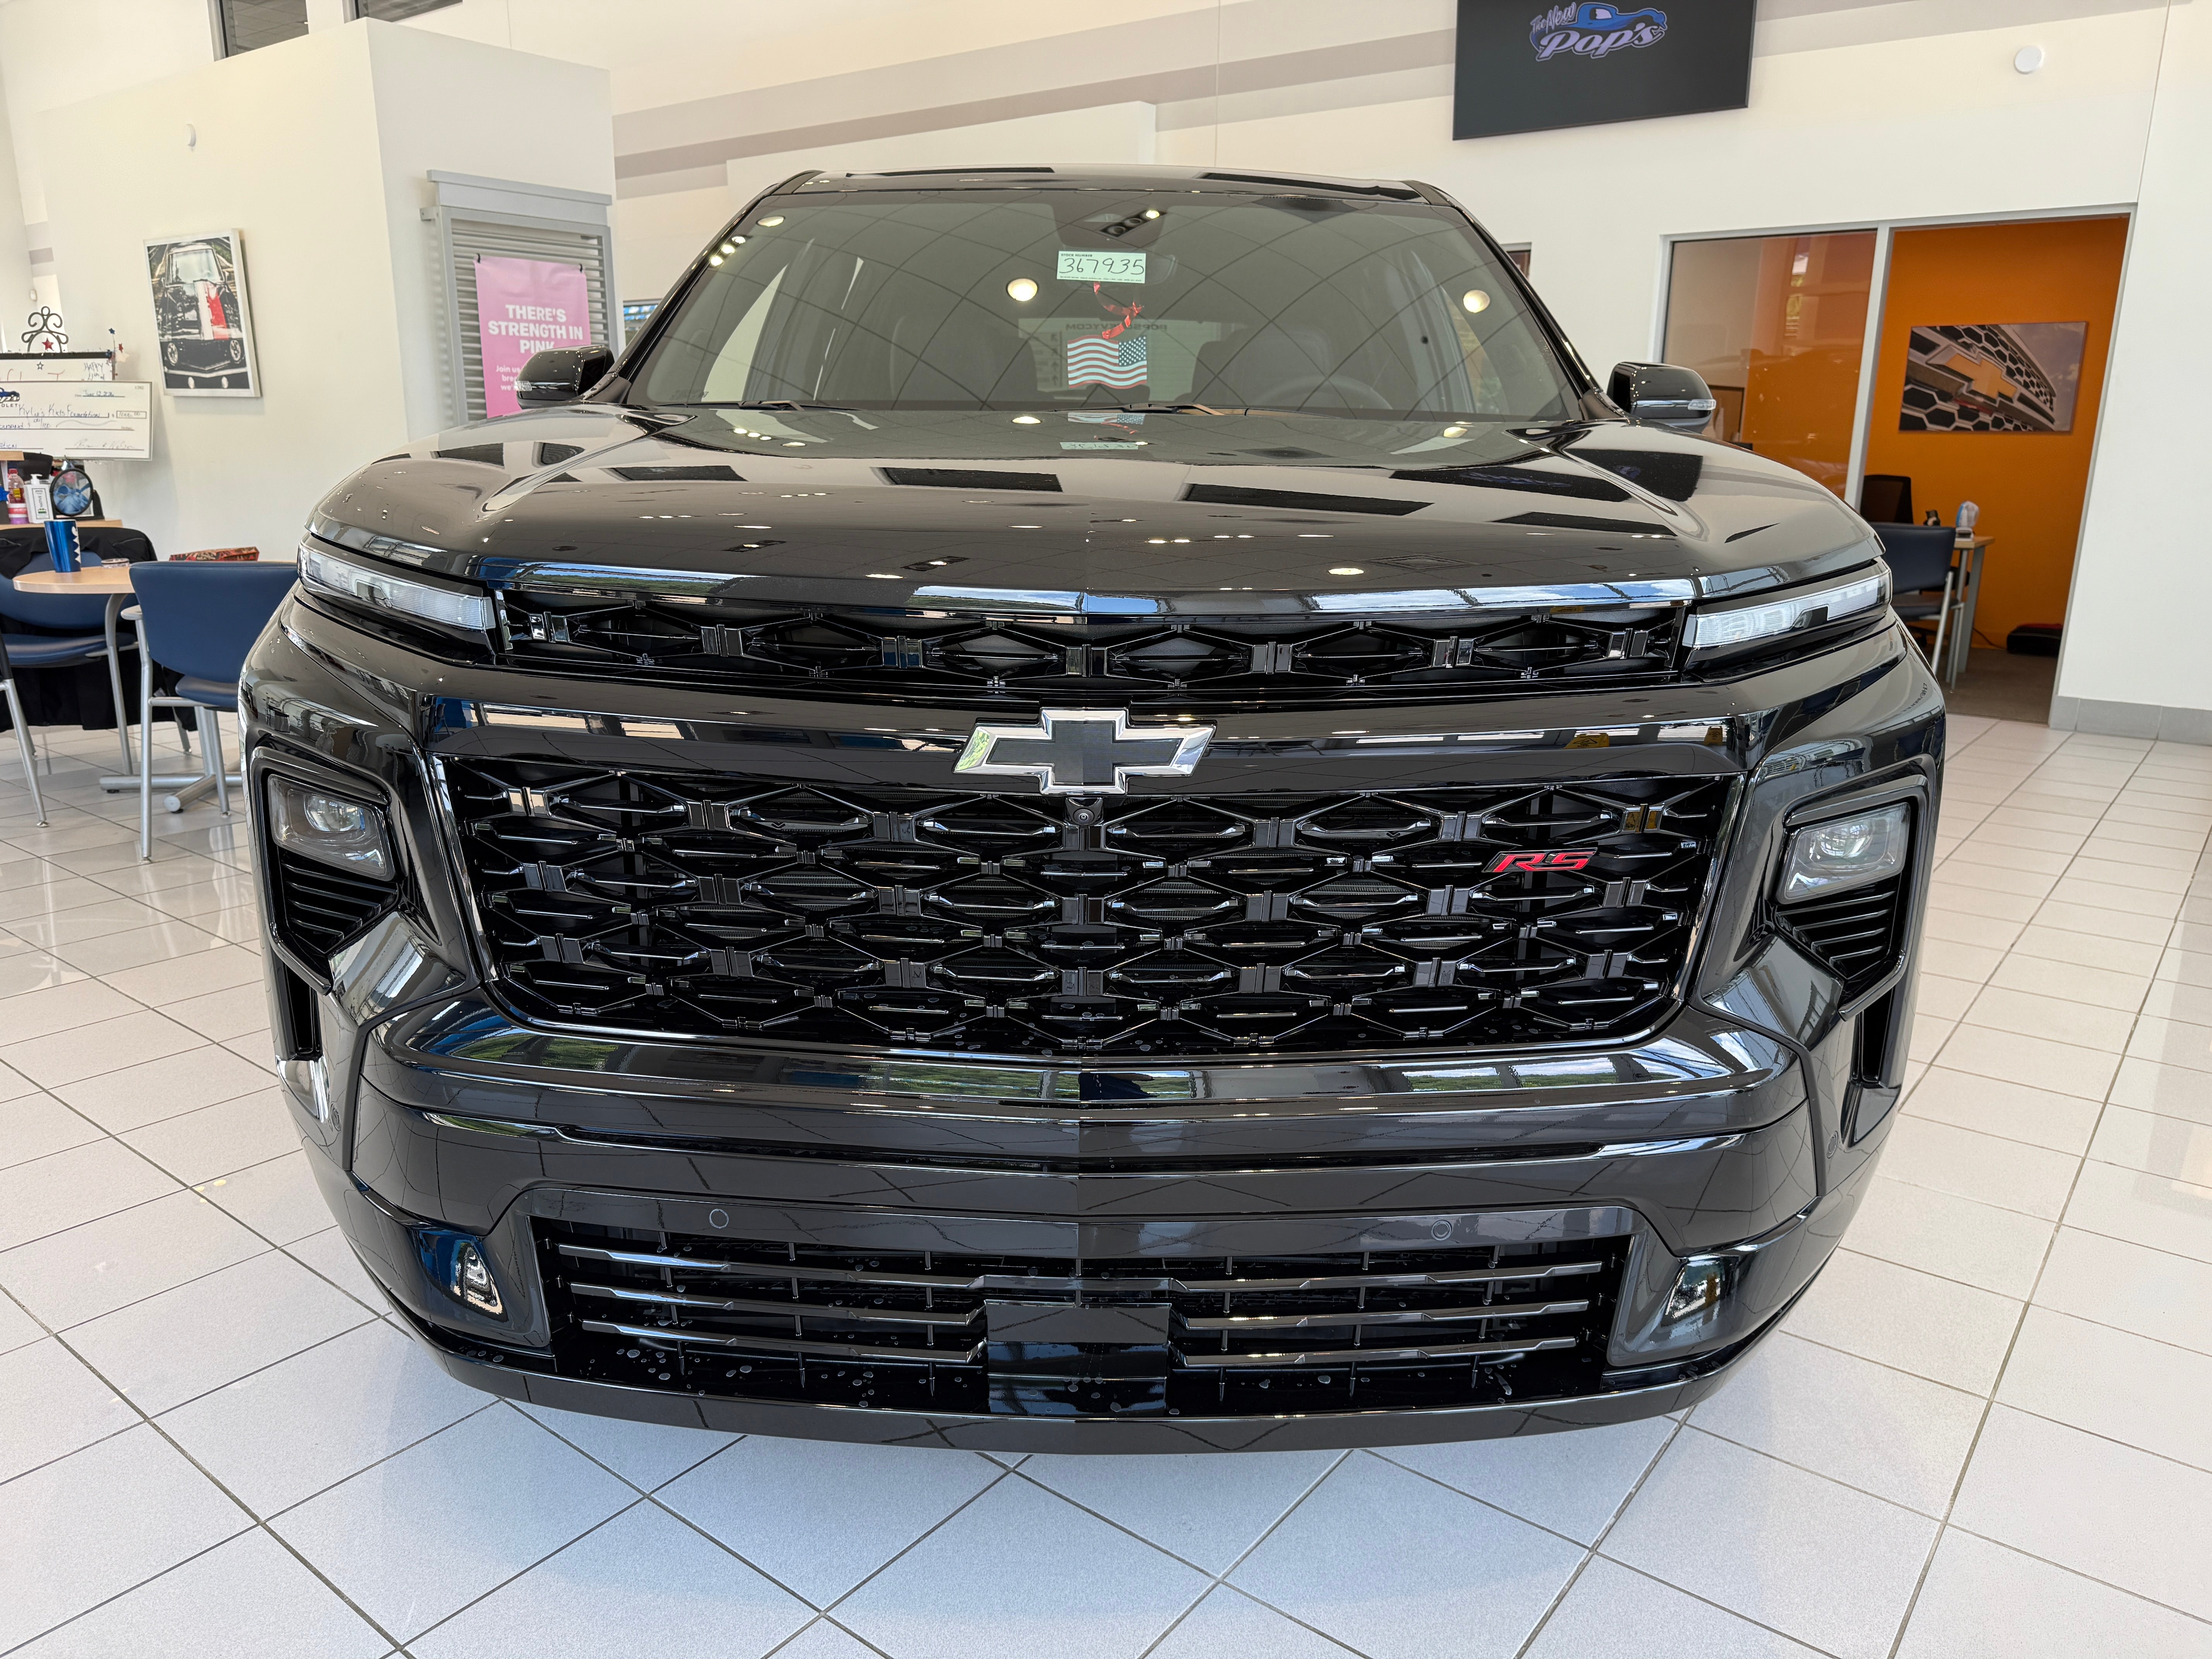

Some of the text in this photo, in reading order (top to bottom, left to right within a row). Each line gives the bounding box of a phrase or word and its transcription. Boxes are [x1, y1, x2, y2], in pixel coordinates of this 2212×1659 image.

[1530, 2, 1577, 34] The New
[1537, 22, 1661, 59] Pop's
[1059, 258, 1144, 275] 367935
[505, 304, 567, 322] THERE'S
[488, 320, 583, 340] STRENGTH IN
[1493, 851, 1596, 872] RS
